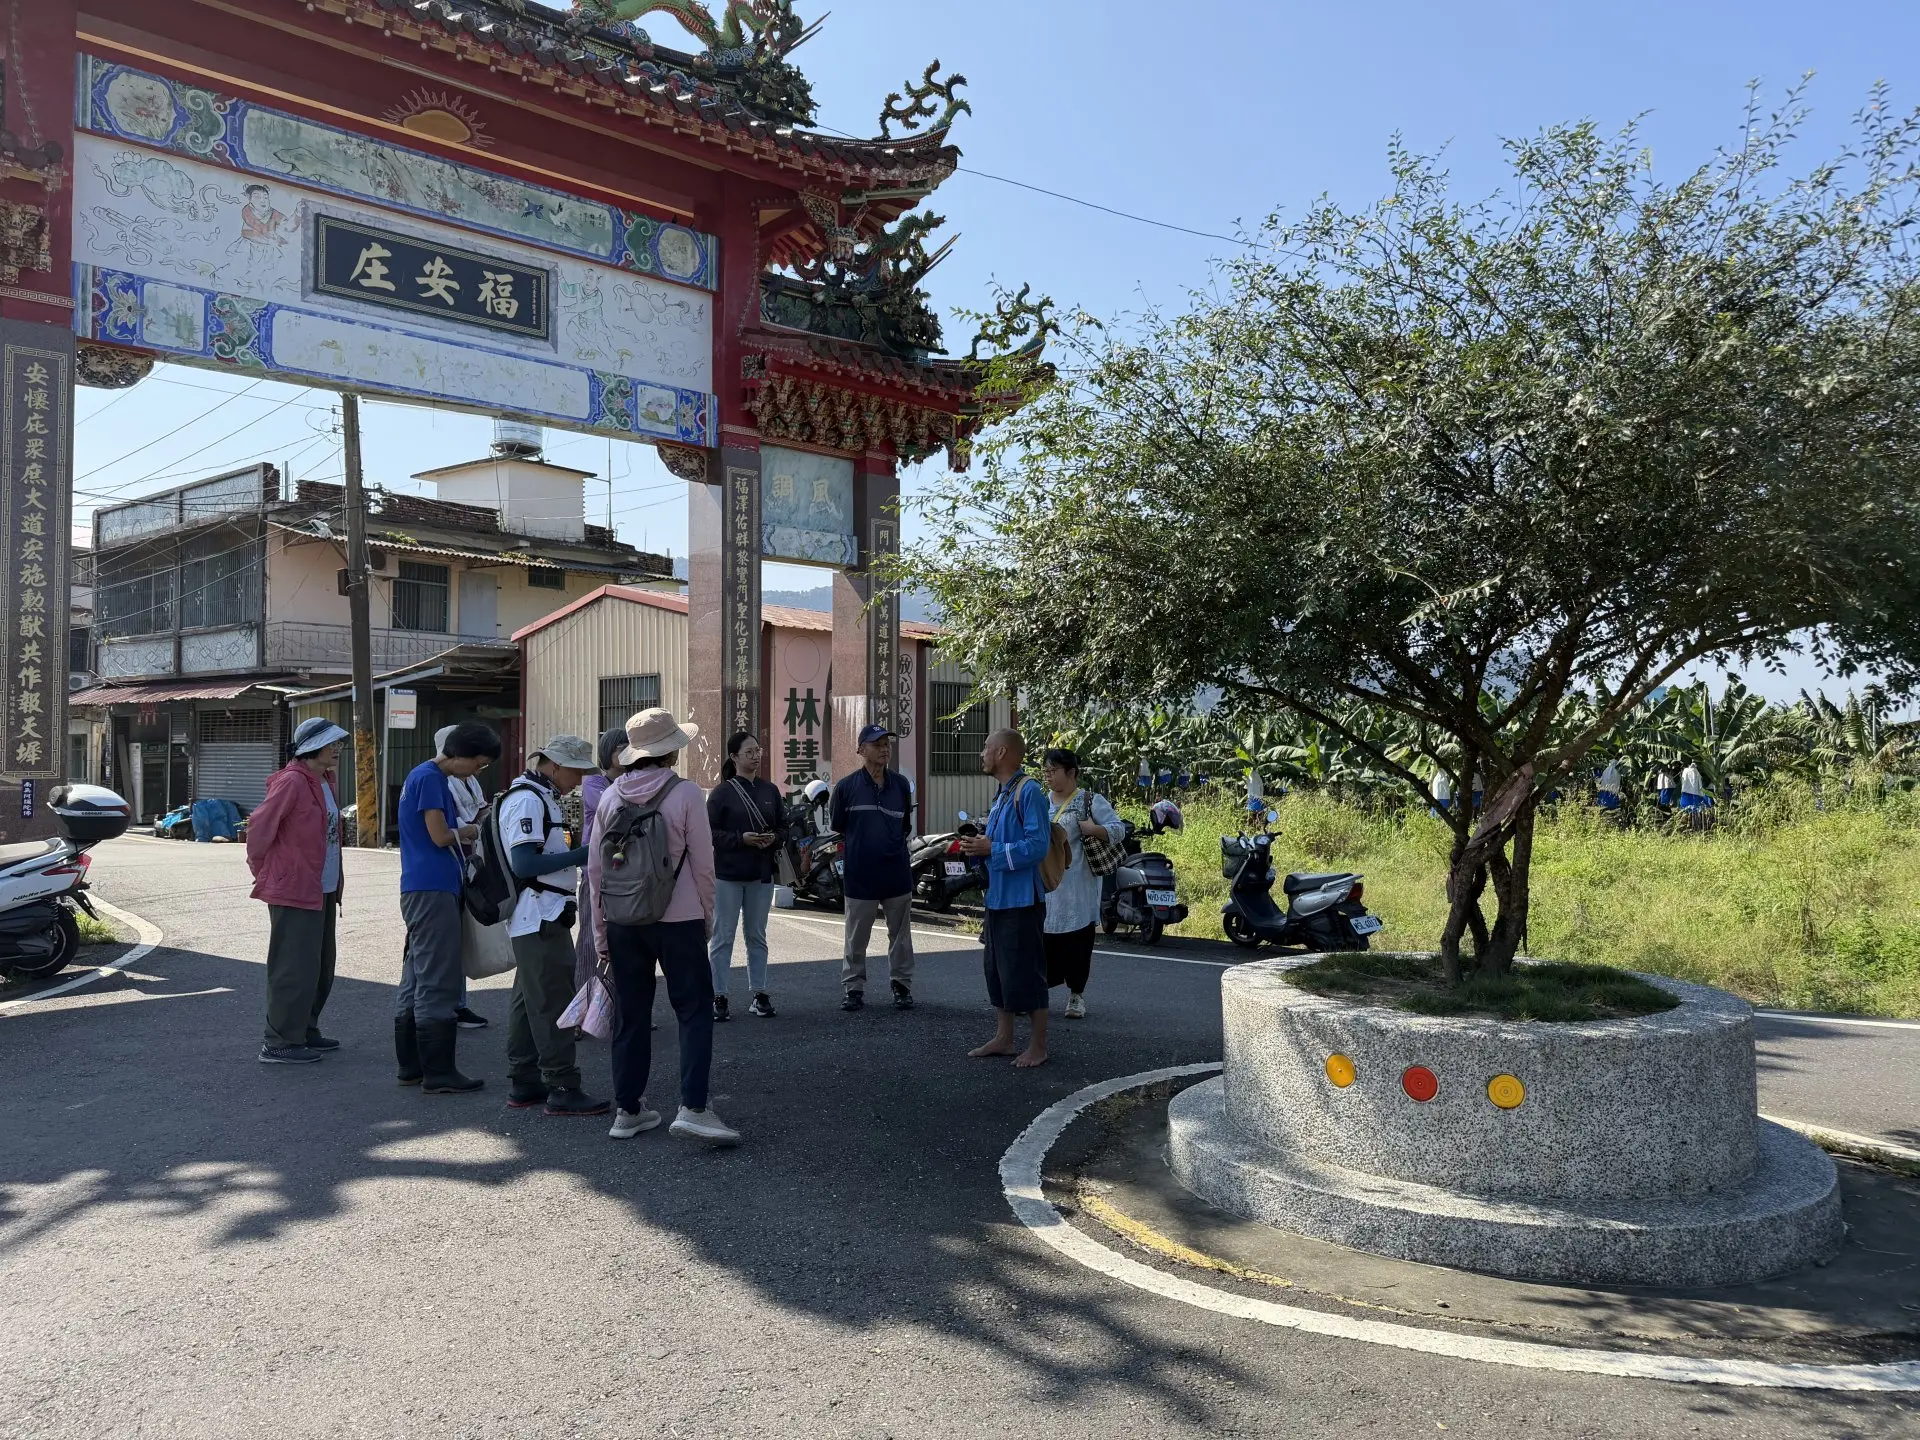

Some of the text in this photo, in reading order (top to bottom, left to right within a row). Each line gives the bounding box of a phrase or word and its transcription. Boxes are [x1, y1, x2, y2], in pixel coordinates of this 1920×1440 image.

[734, 477, 750, 734] 福澤佑群黎鸞門聖化早覺靜悟登
[783, 687, 821, 807] 林慧
